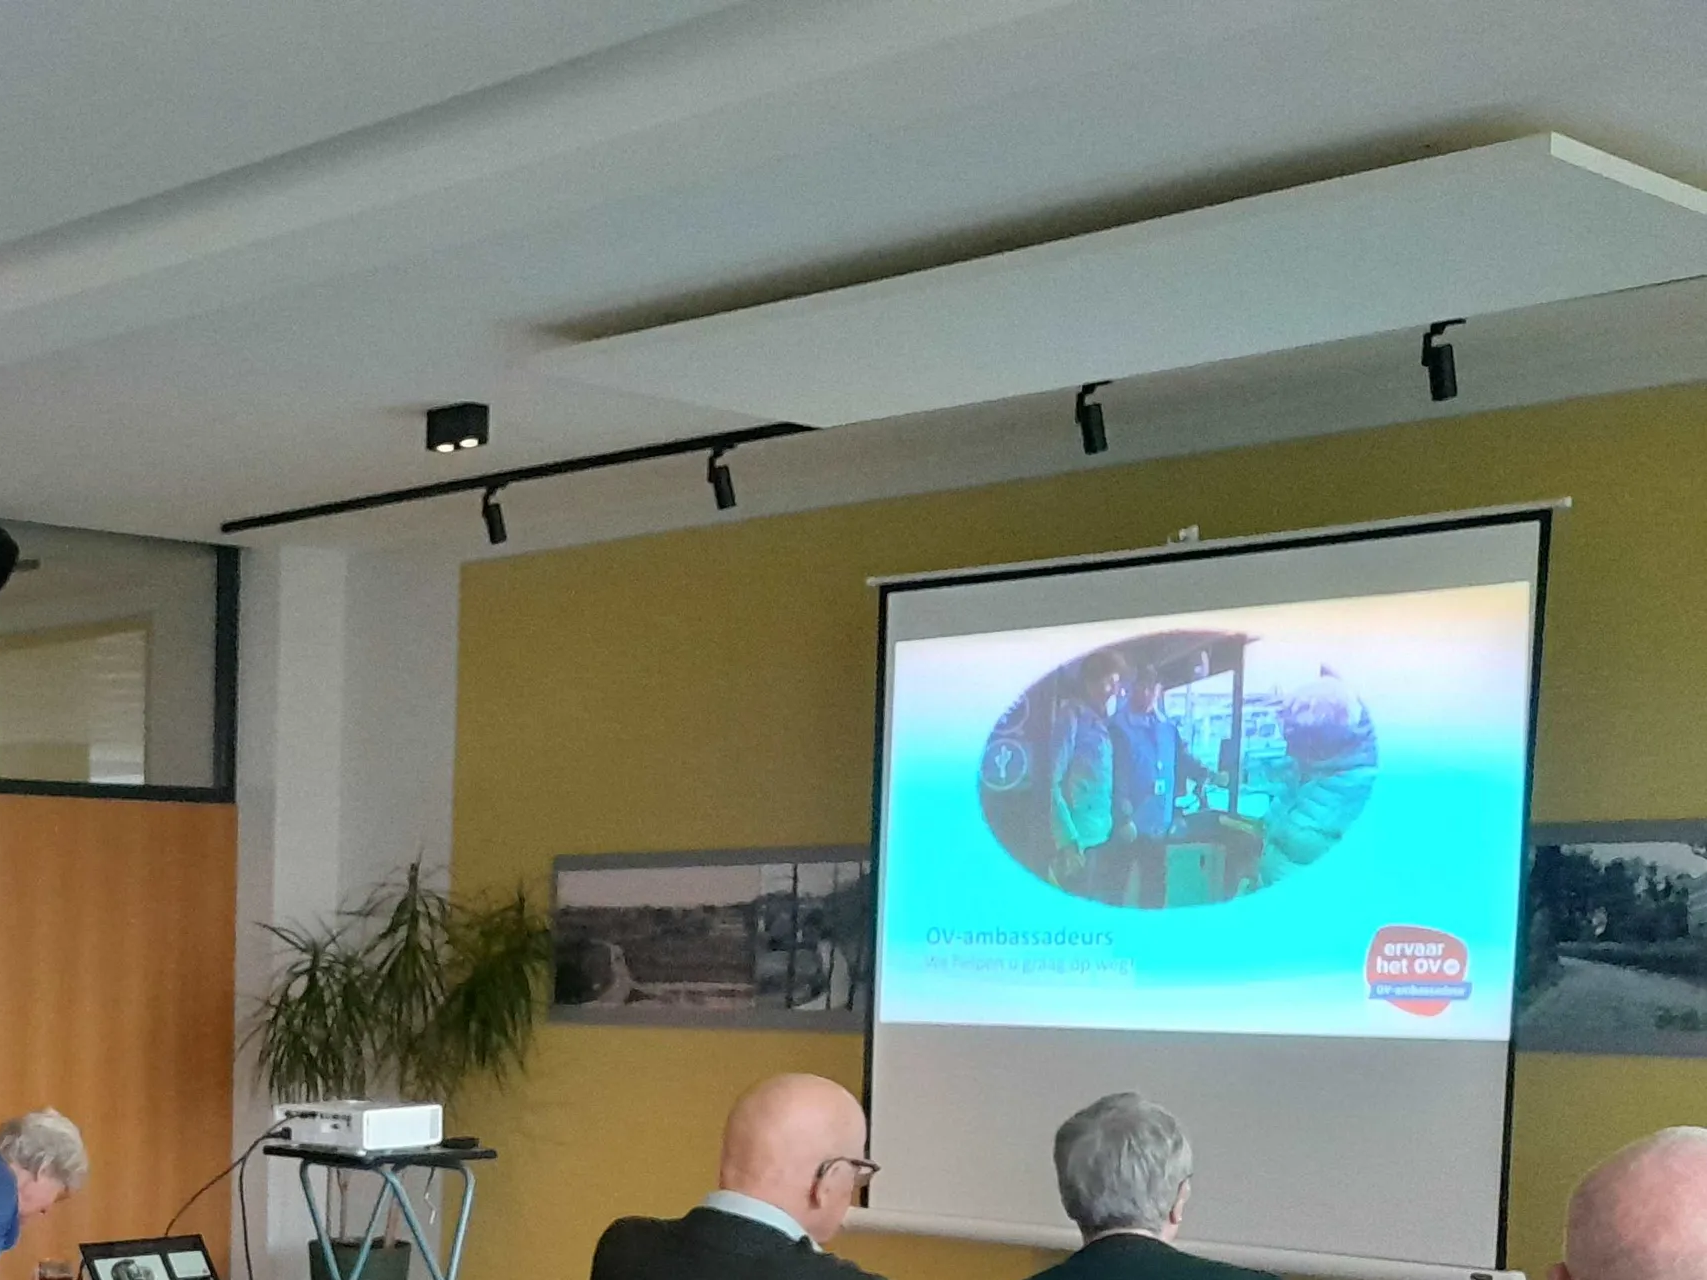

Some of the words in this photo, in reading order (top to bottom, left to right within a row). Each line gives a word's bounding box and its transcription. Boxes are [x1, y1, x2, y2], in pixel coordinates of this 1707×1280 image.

[925, 926, 1114, 947] OV-ambassadeurs
[1383, 942, 1445, 957] ervaar
[1376, 956, 1408, 975] het
[1413, 958, 1443, 975] OV
